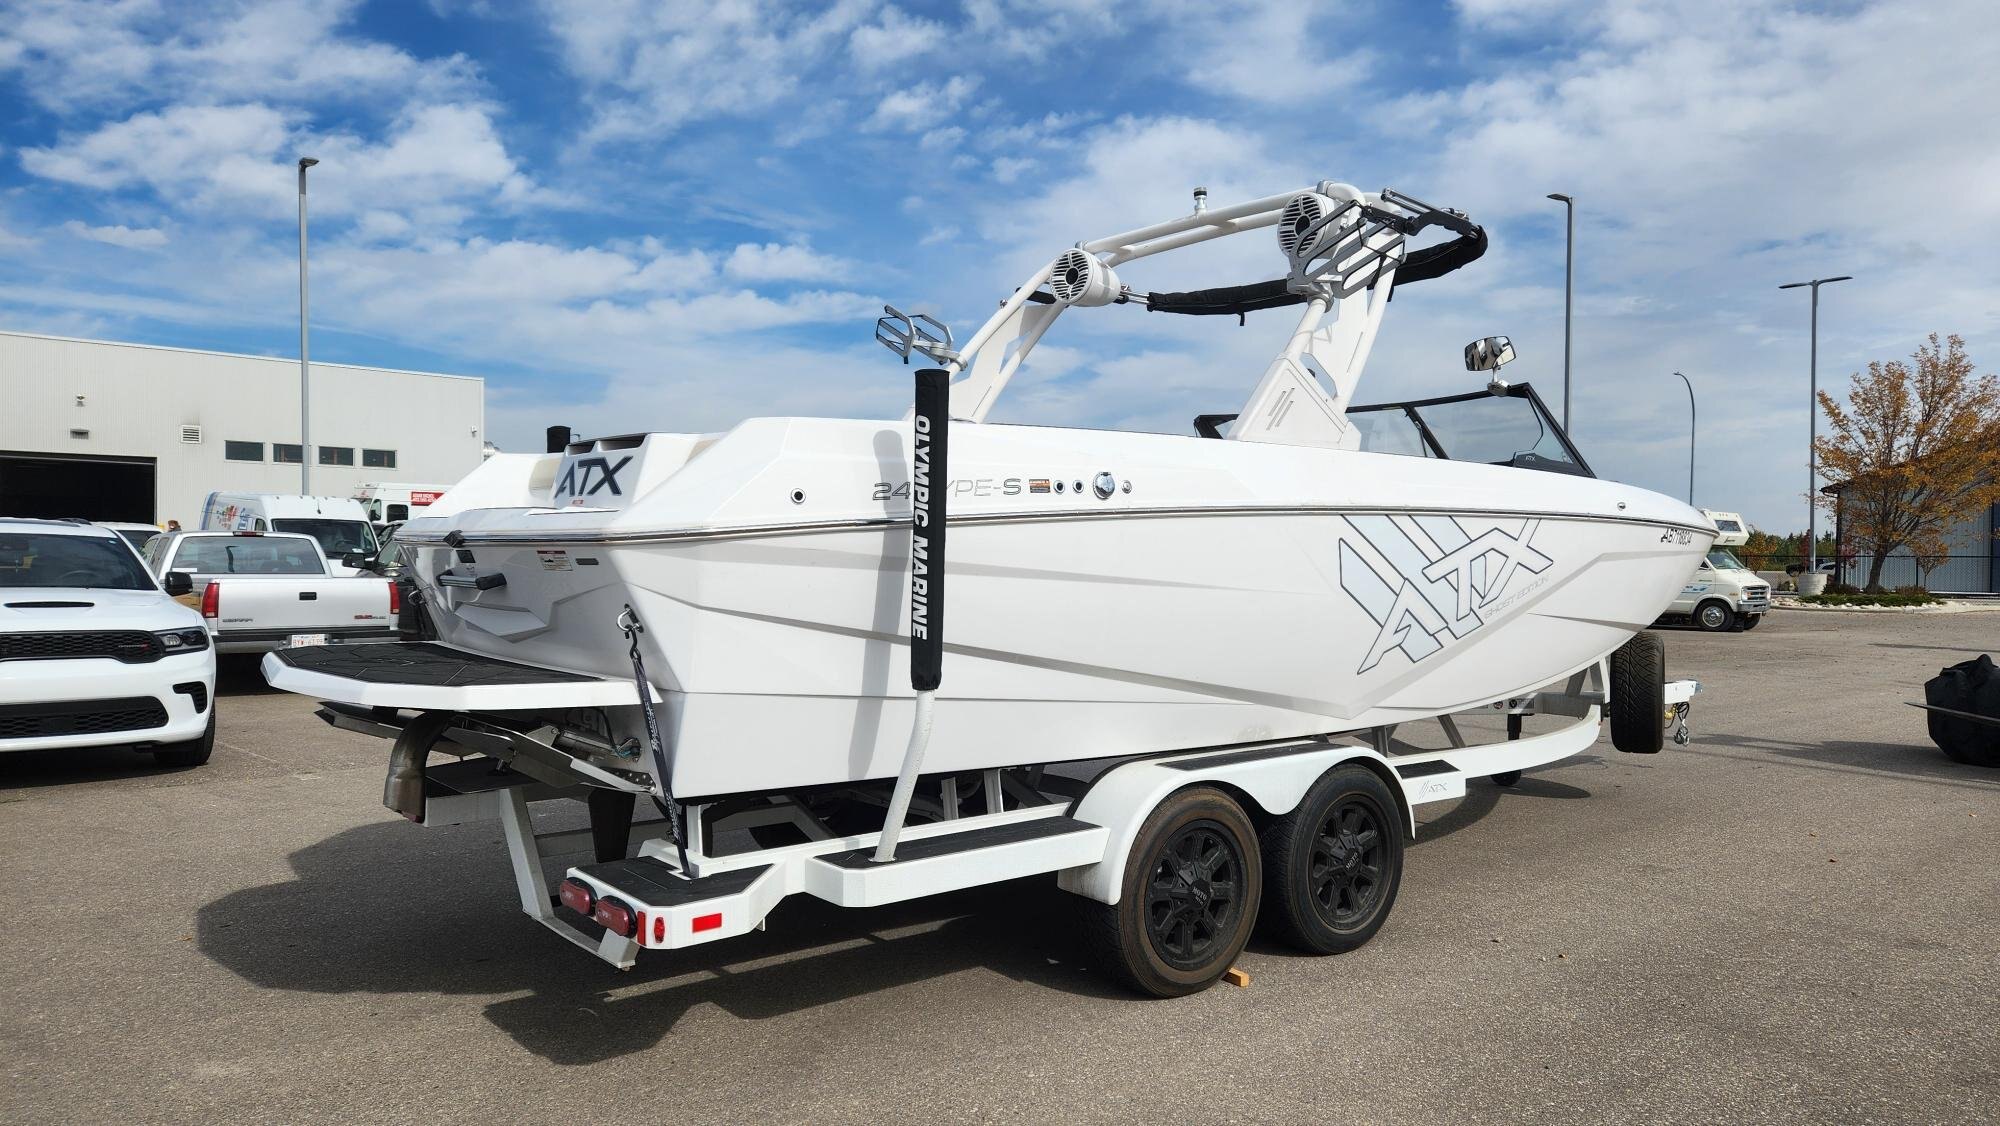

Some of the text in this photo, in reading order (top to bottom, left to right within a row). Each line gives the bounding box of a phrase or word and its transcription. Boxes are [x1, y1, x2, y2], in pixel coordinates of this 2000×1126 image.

[553, 455, 634, 499] ATX
[872, 481, 911, 501] 24
[912, 414, 931, 641] OLYMPIC MARINE
[1357, 517, 1553, 675] ATX
[1428, 782, 1448, 793] ATX
